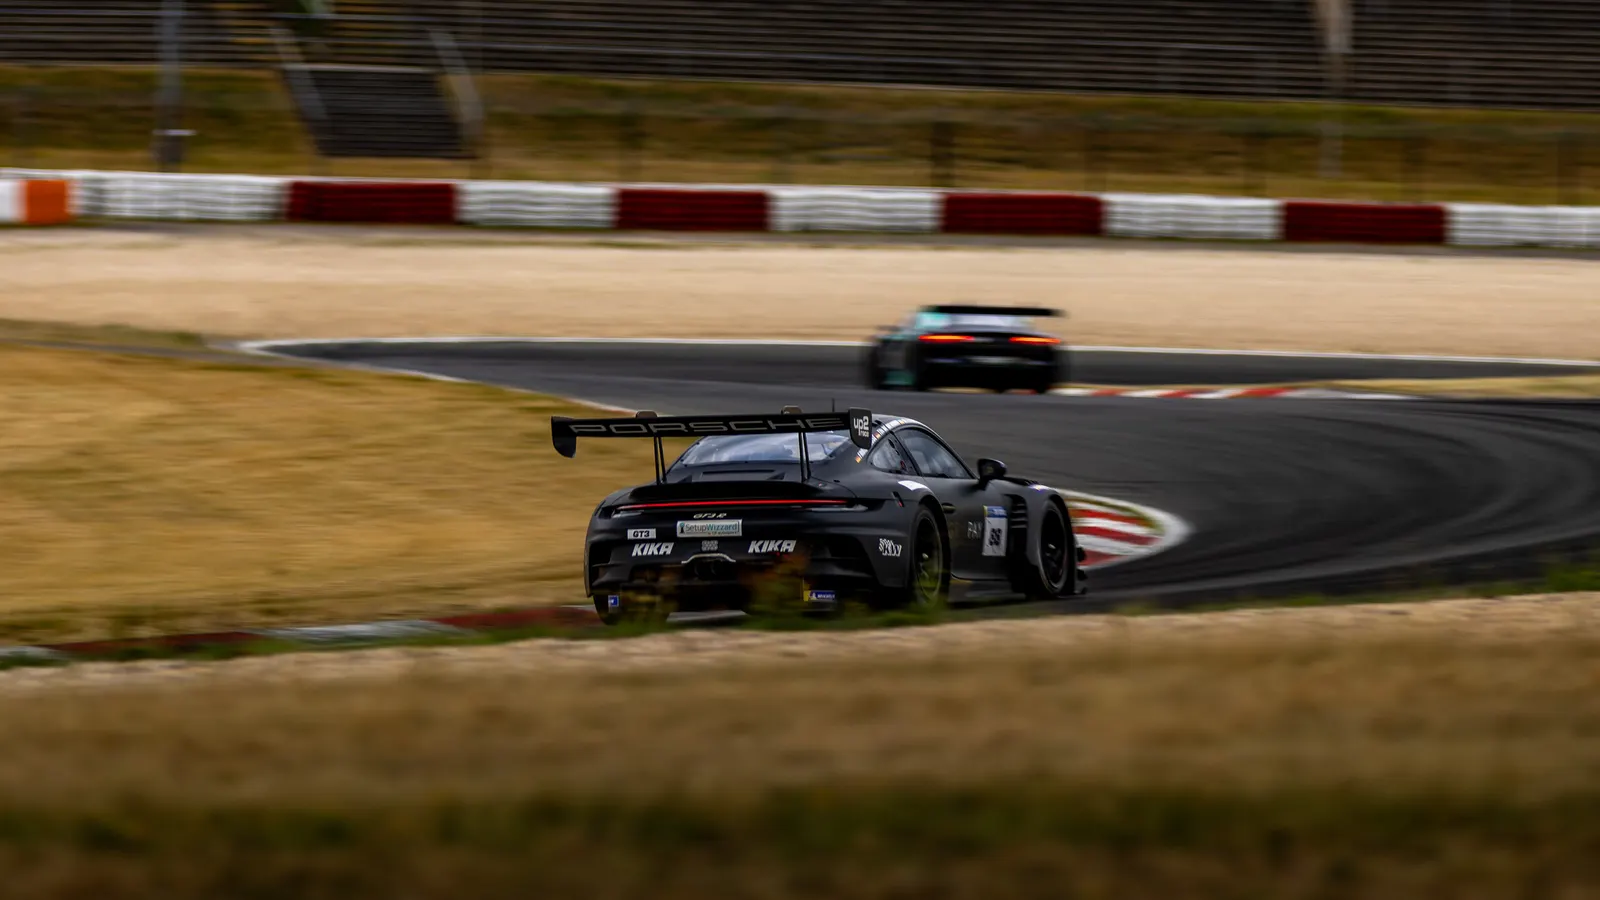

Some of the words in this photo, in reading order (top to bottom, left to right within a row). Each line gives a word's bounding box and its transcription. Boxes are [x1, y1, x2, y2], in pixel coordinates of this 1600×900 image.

[569, 417, 845, 434] PORSCHE
[853, 415, 870, 436] up2
[632, 530, 651, 538] GT3
[685, 521, 738, 533] SetupWizzard
[631, 542, 675, 557] KIKA
[748, 539, 797, 554] KIKA
